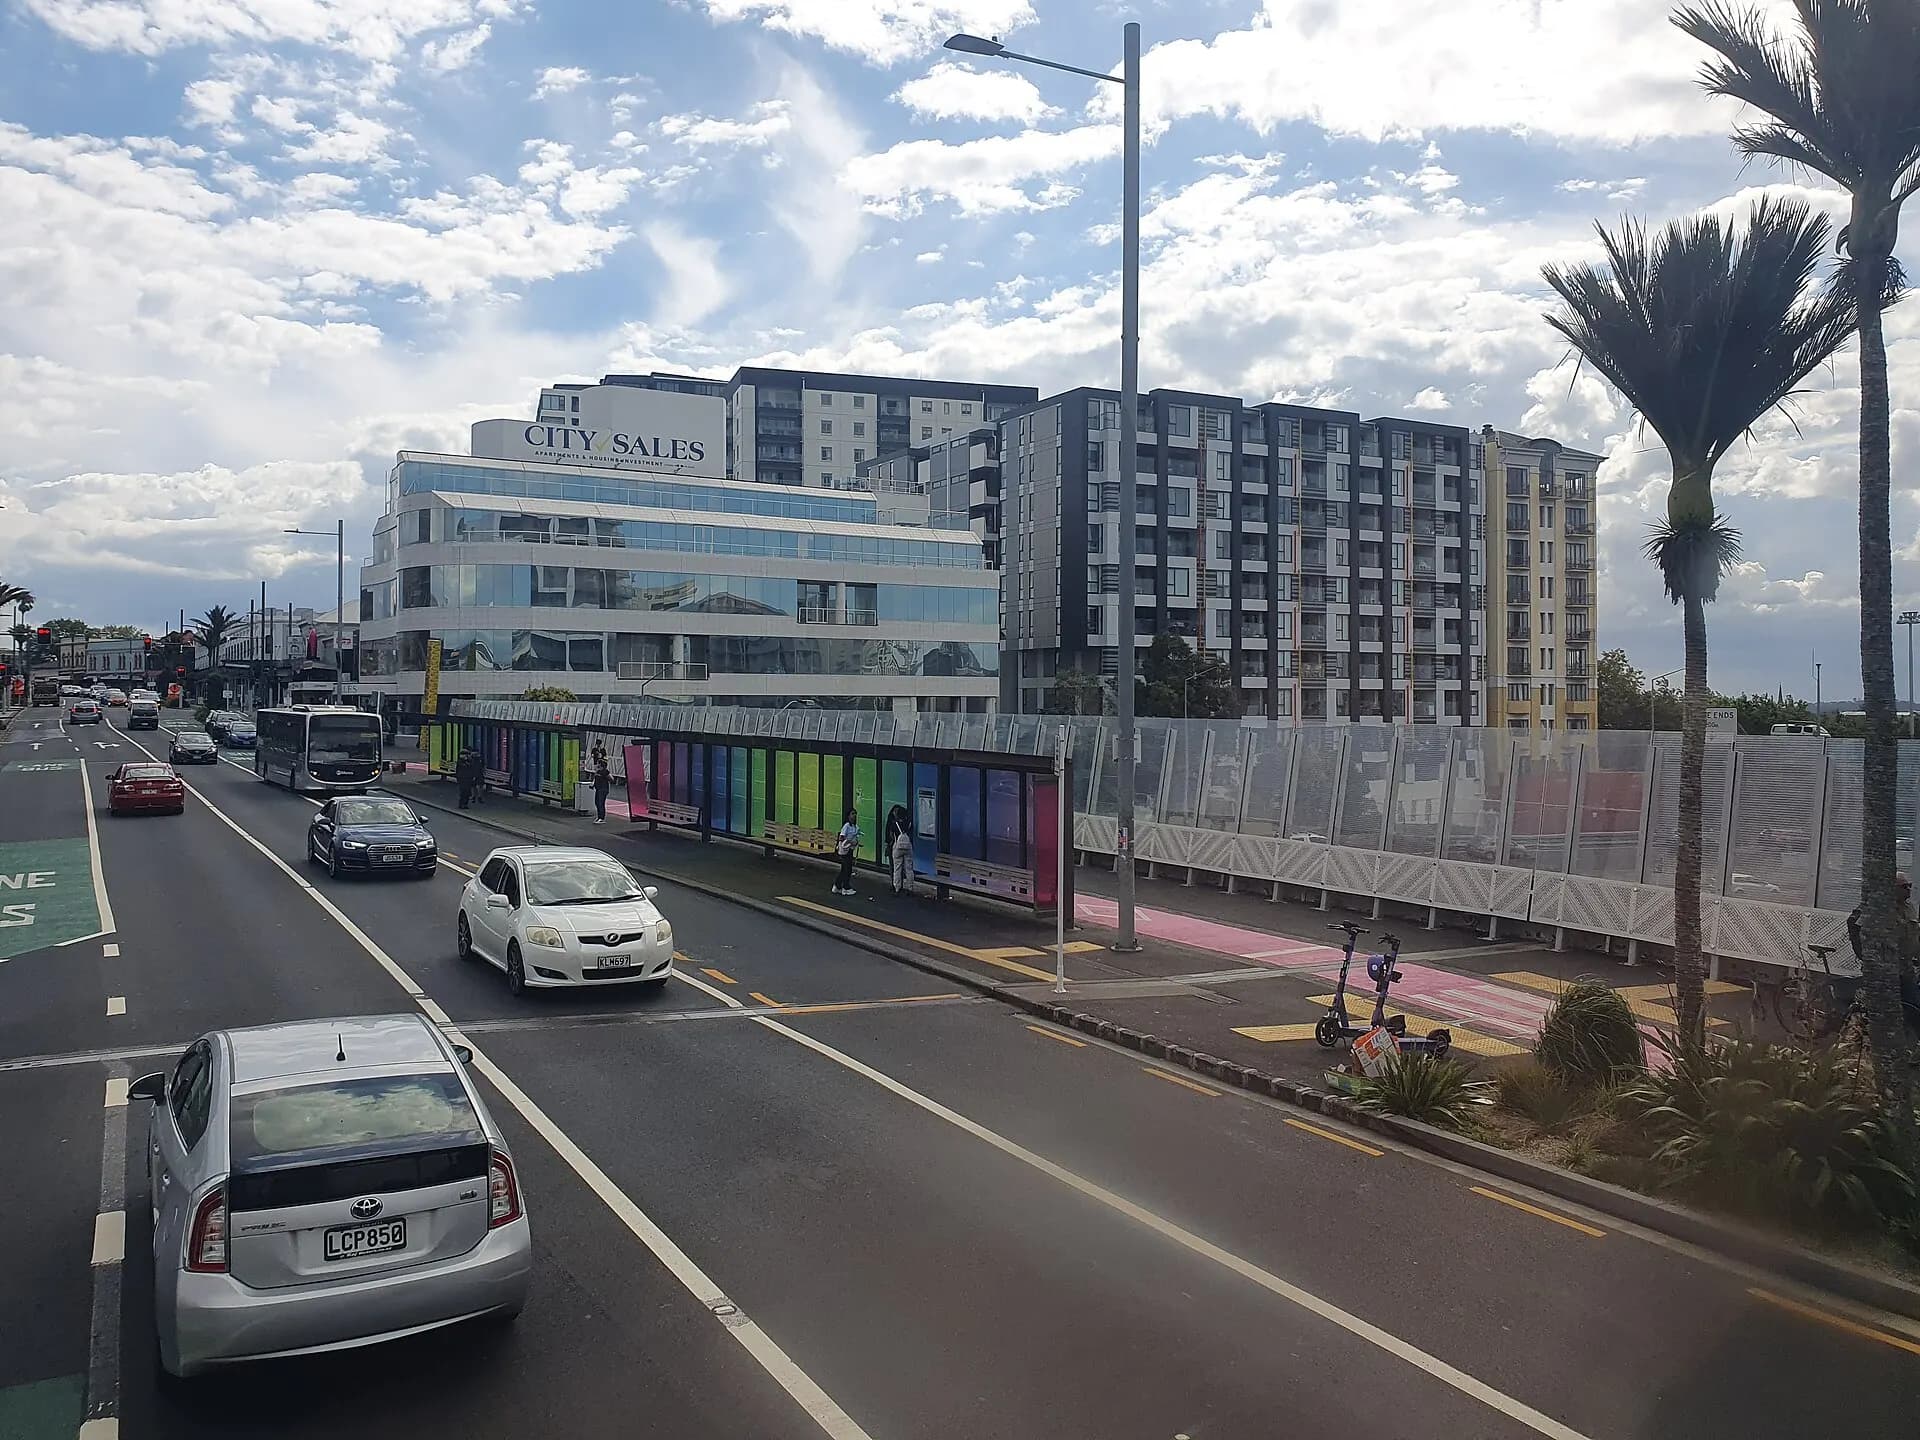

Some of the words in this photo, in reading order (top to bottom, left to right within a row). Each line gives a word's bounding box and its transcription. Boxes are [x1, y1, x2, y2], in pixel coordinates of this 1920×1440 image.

[524, 425, 598, 451] CITY
[612, 433, 705, 462] SALES
[620, 458, 663, 467] NVESTMENT
[1713, 711, 1734, 719] ENDS
[328, 1225, 402, 1254] LCP850
